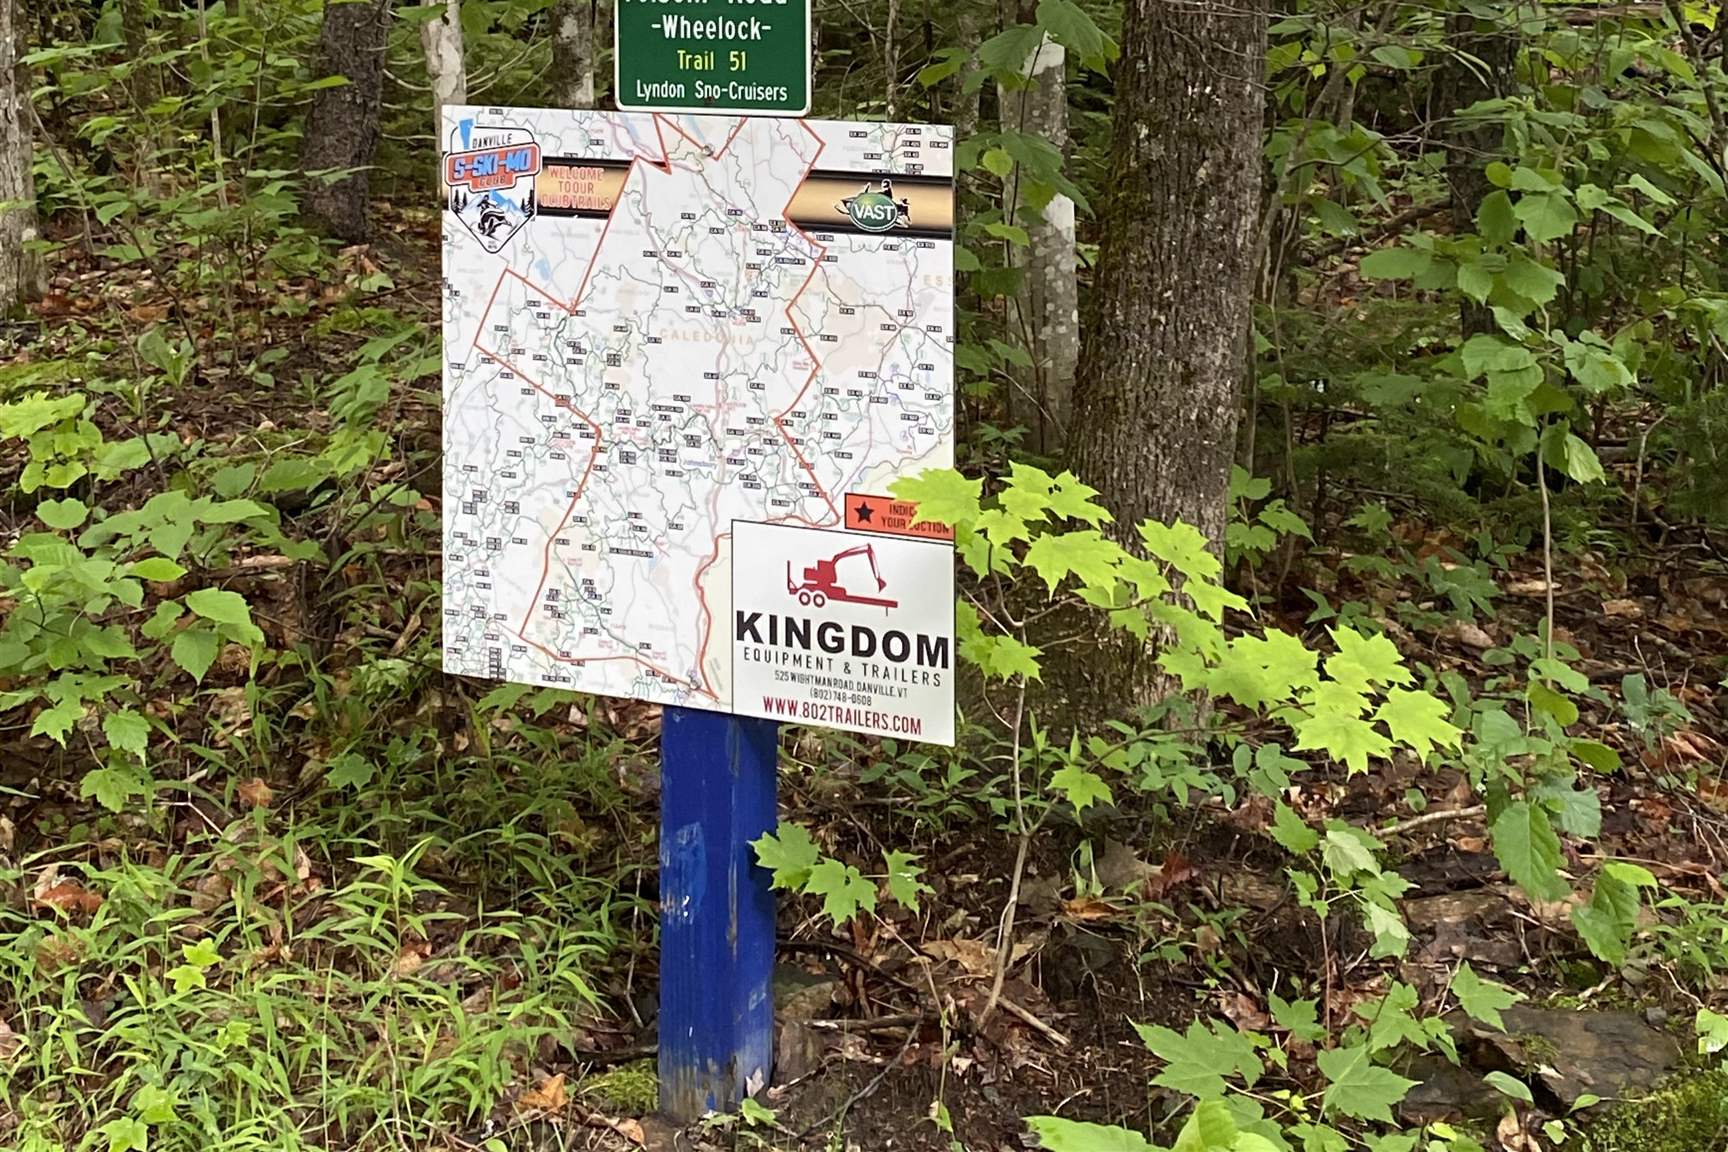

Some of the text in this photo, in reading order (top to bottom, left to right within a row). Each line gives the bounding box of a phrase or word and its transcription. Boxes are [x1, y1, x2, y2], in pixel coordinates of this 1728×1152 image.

[677, 50, 746, 71] Trail 51
[636, 80, 788, 102] Lyndon Sno-Cruisers
[472, 133, 513, 148] DANVILLE
[549, 166, 604, 182] WELCOME
[854, 203, 895, 221] VAST
[881, 516, 906, 529] YOUR
[736, 610, 949, 670] KINGDOM
[743, 647, 941, 687] EQUIPMENT & TRAILERS
[774, 670, 789, 681] 525
[898, 687, 908, 699] VT
[763, 696, 922, 736] WWW.802TRAILERS.COM
